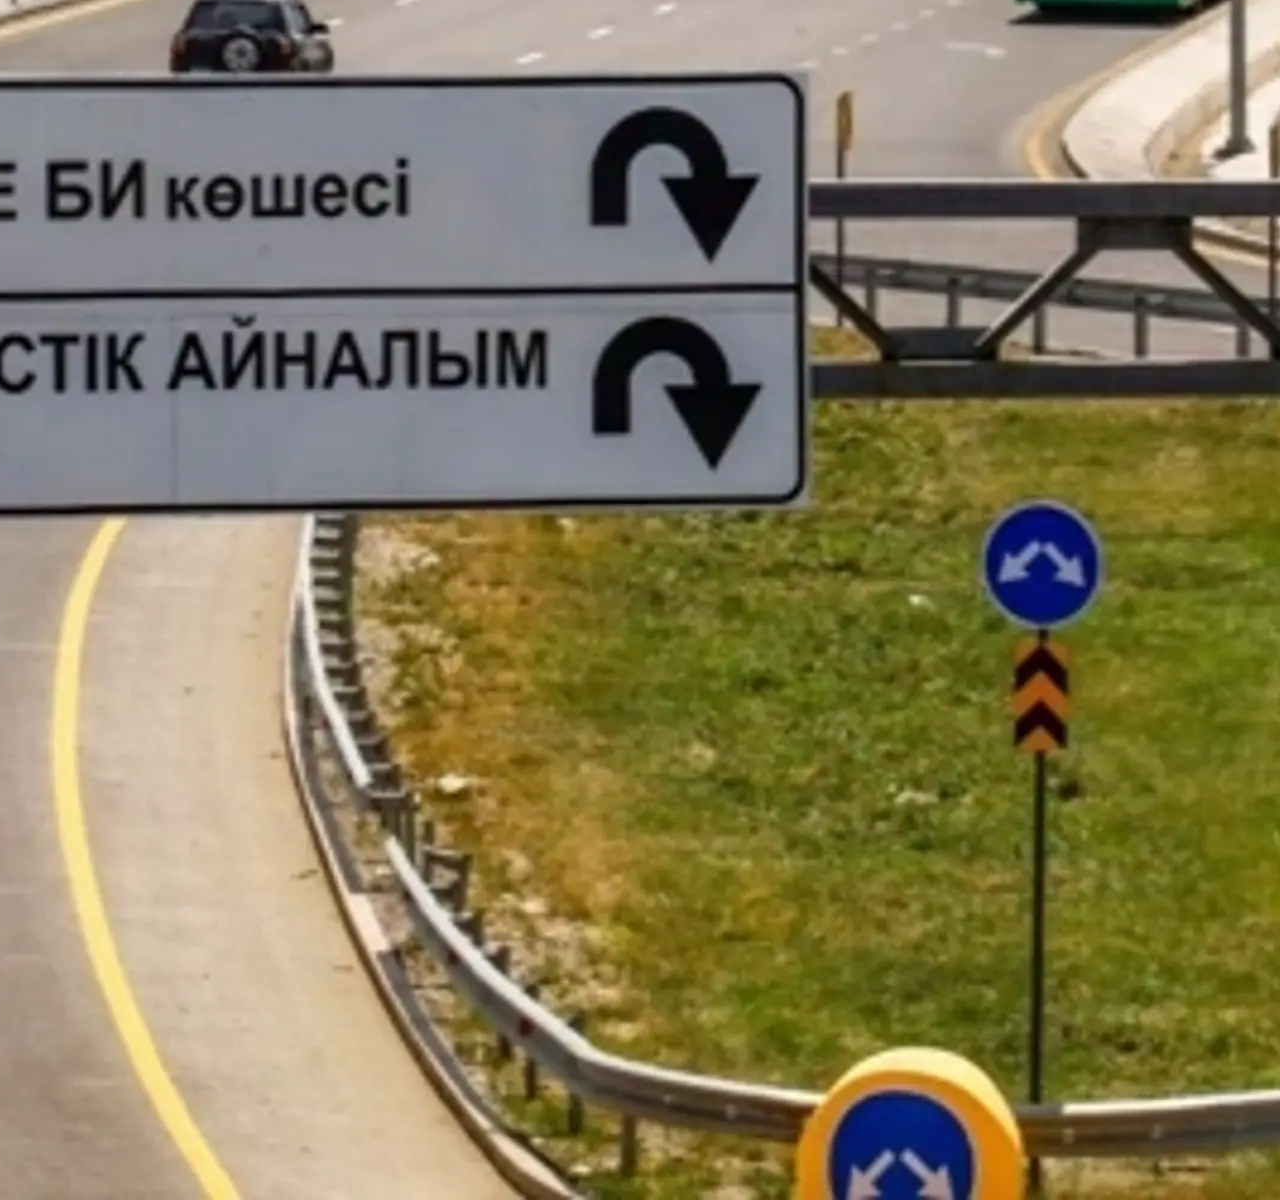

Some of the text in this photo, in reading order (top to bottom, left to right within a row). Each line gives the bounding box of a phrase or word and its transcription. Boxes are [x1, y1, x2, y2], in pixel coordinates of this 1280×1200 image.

[44, 159, 147, 222] БИ
[165, 157, 410, 221] көшесі
[165, 315, 549, 393] АЙНАЛЫМ
